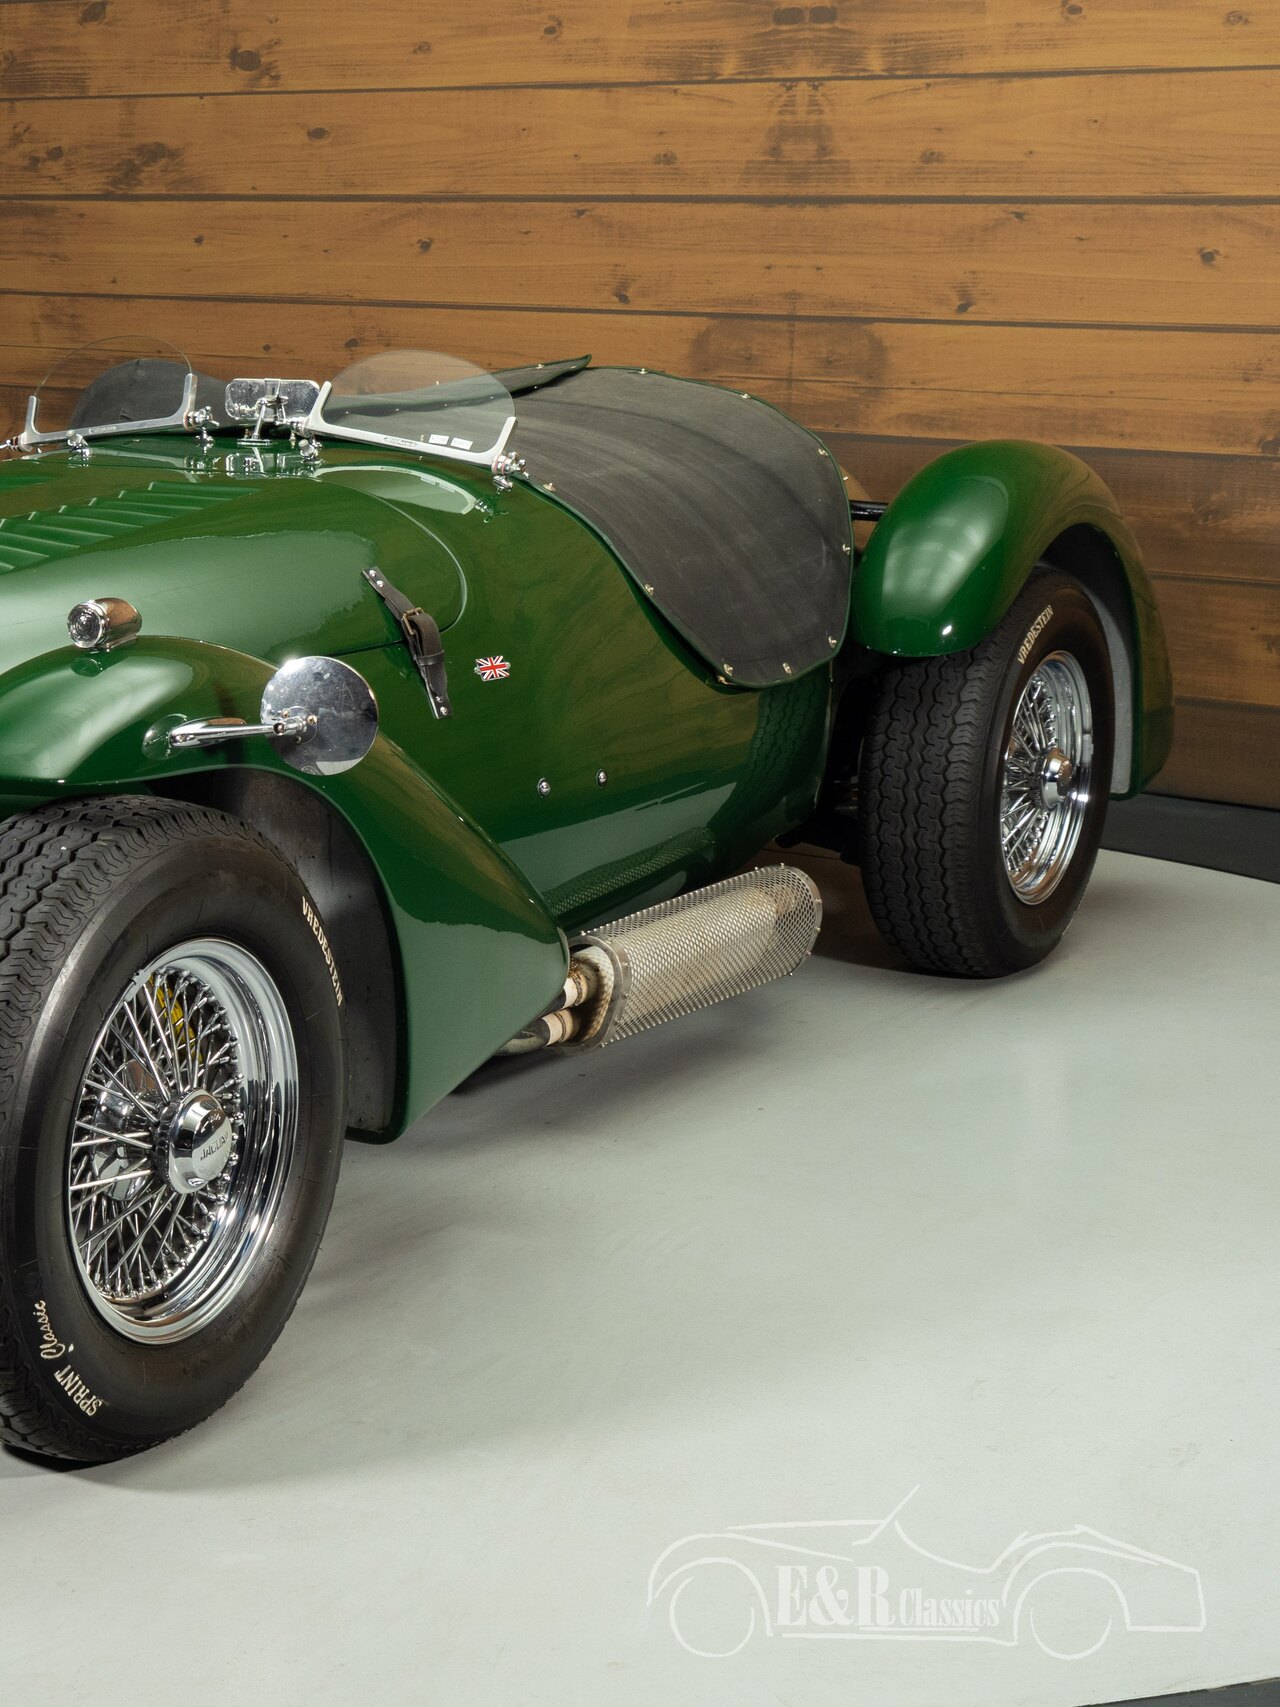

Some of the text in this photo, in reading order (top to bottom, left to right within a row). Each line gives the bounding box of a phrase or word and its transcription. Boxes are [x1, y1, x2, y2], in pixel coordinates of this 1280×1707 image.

[1017, 604, 1054, 665] VREDESTEIN
[302, 895, 343, 1007] VREDESTEIN
[33, 1300, 103, 1417] SPRINT Classic
